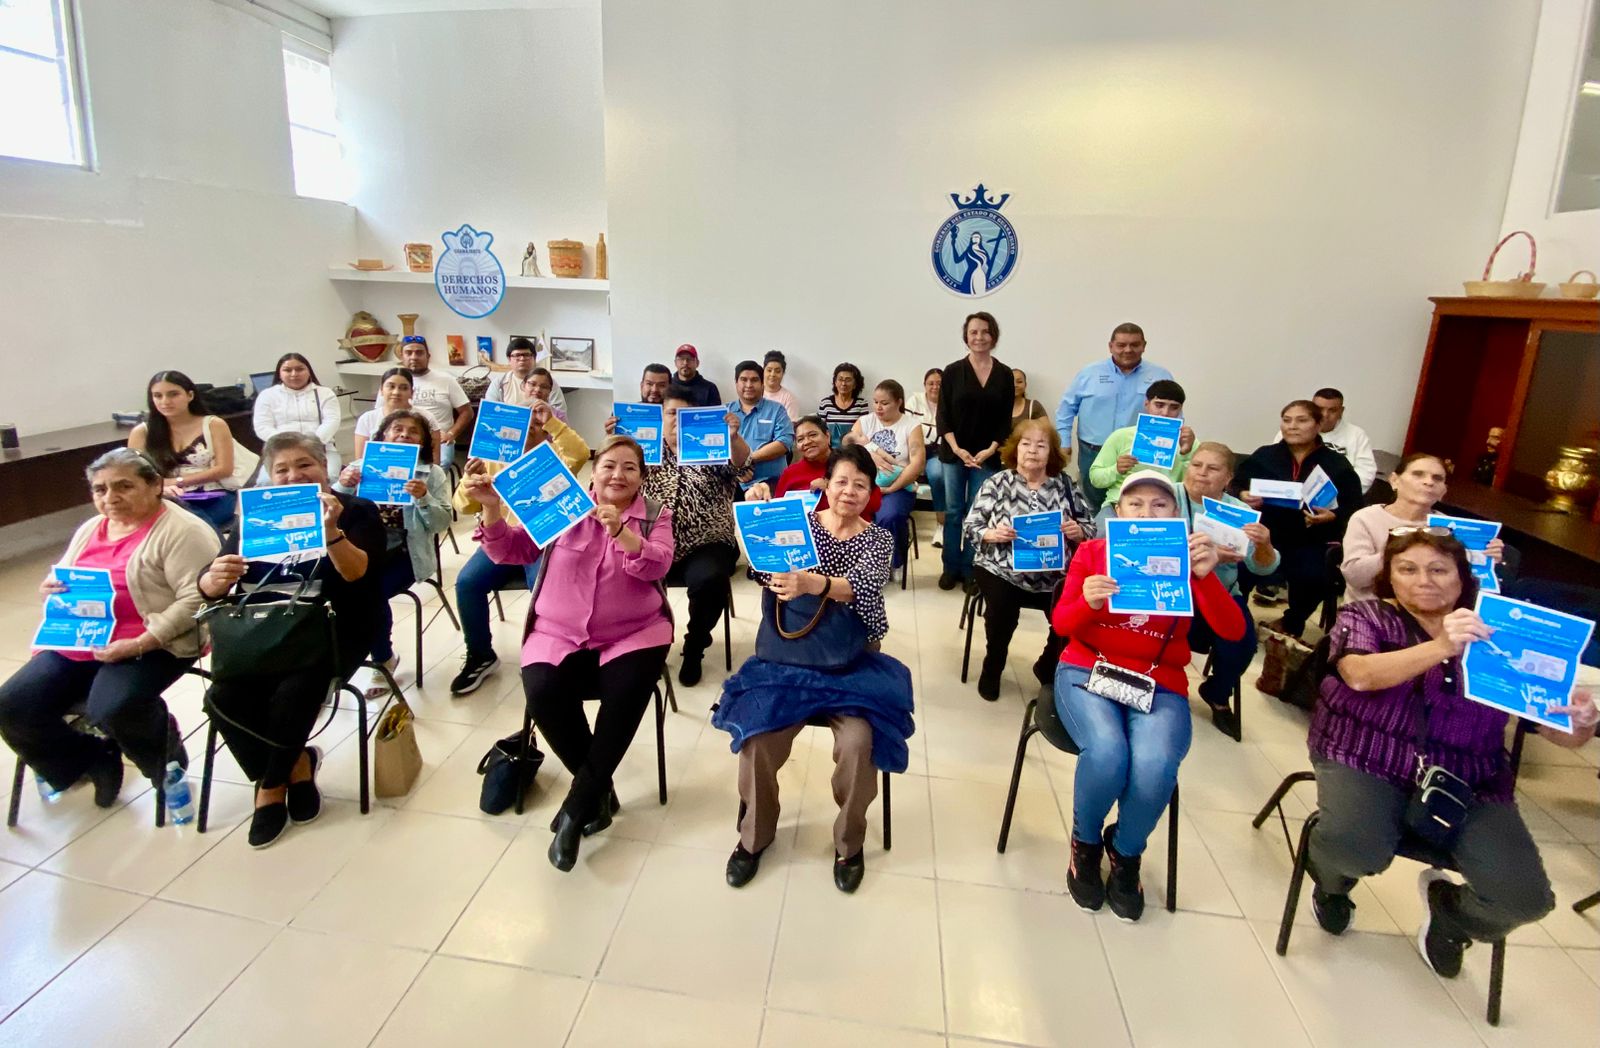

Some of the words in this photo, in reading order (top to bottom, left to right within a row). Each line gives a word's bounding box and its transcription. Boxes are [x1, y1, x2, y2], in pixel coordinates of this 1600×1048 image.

[935, 223, 952, 253] GOBIERNO
[951, 215, 962, 224] DEL
[963, 210, 988, 218] ESTADO
[996, 216, 1016, 255] GUANAJUATO
[441, 275, 499, 285] DERECHOS
[444, 286, 498, 295] HUMANOS
[1151, 586, 1185, 608] Viaje!
